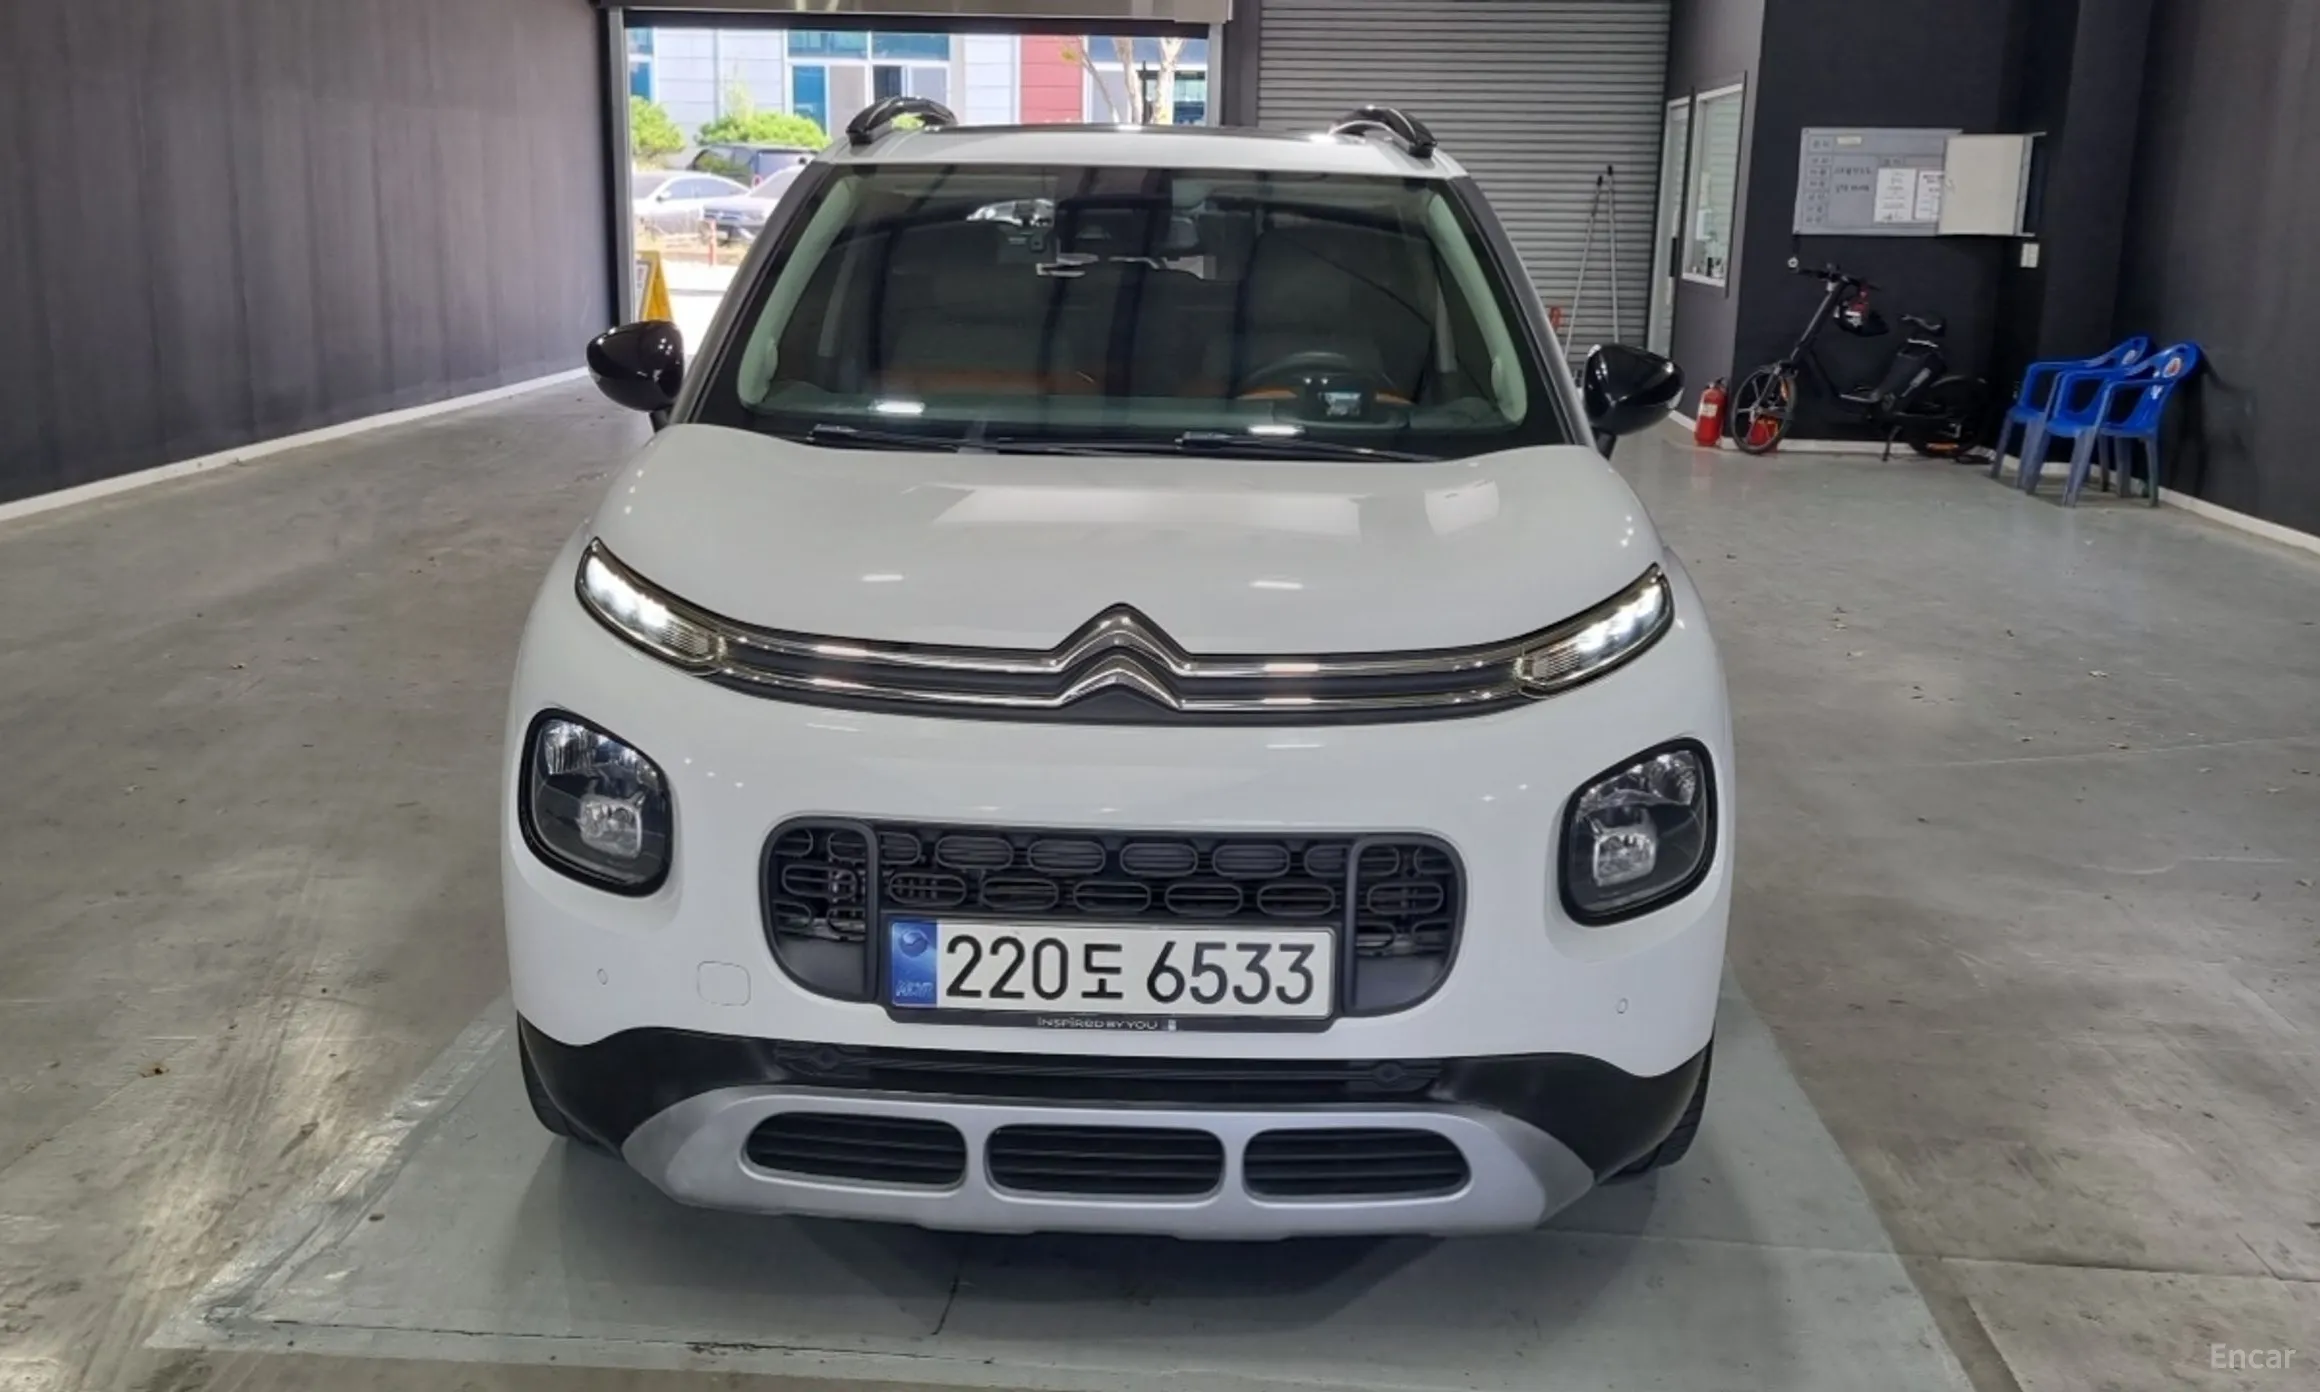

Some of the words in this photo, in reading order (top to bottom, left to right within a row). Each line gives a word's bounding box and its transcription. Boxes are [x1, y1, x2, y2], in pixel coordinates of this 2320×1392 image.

[945, 934, 1124, 1000] 220도
[1146, 940, 1315, 1005] 6533
[1126, 1020, 1158, 1030] YOU
